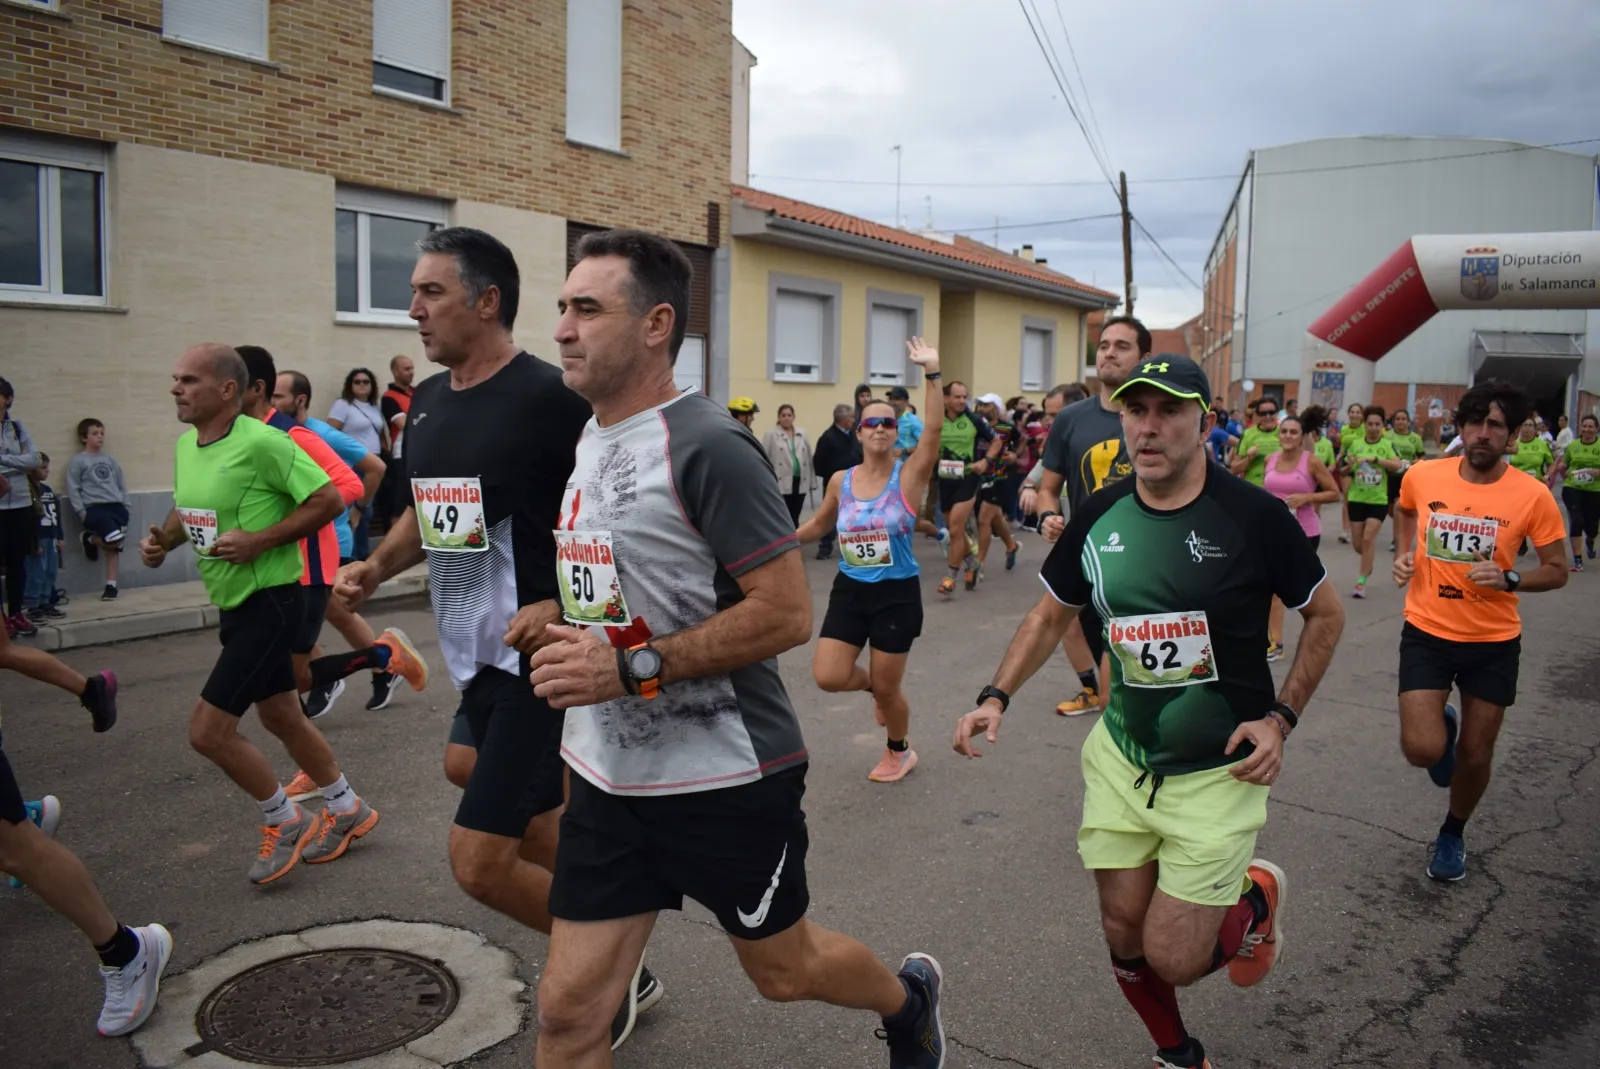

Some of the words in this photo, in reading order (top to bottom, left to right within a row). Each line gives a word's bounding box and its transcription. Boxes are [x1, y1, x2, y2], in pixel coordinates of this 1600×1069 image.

[1502, 251, 1582, 269] Diputación
[1501, 281, 1514, 291] de
[1519, 277, 1596, 291] Salamanca
[1327, 321, 1351, 344] CON
[1350, 310, 1367, 324] EL
[1365, 266, 1417, 312] DEPORTE
[413, 483, 481, 504] bedunia
[432, 504, 459, 534] 49
[1428, 516, 1495, 537] bedunia
[189, 526, 205, 547] 55
[840, 531, 888, 545] bedunia
[1440, 531, 1481, 553] 113
[855, 543, 876, 559] 35
[571, 564, 595, 602] 50
[1110, 616, 1208, 644] bedunia
[1140, 640, 1182, 671] 62
